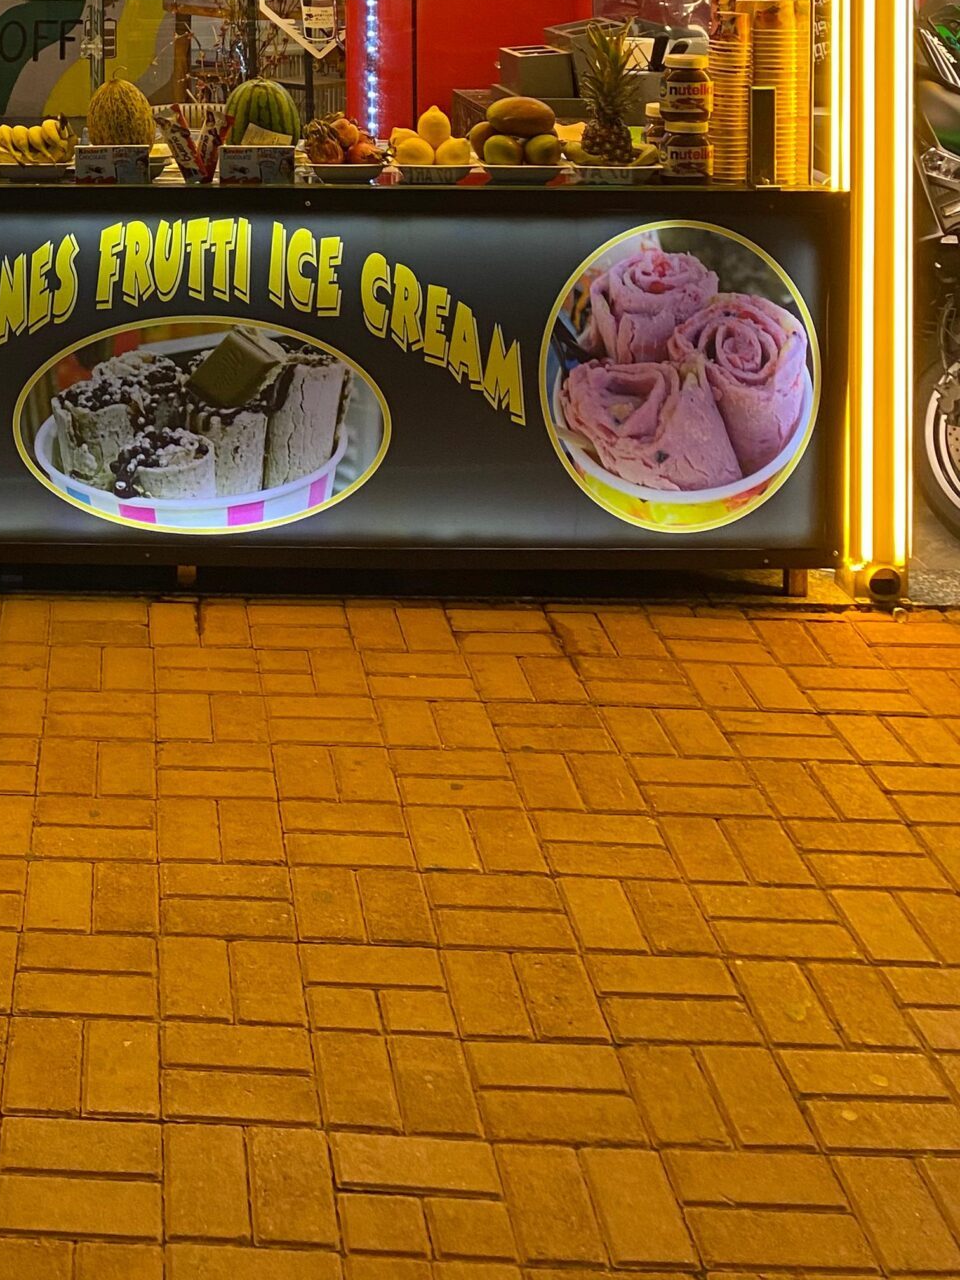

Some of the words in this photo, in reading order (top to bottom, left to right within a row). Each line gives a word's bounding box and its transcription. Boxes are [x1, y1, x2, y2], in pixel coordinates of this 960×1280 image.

[95, 217, 251, 310] FRUTTI
[268, 221, 342, 317] ICE
[360, 251, 527, 426] CREAM
